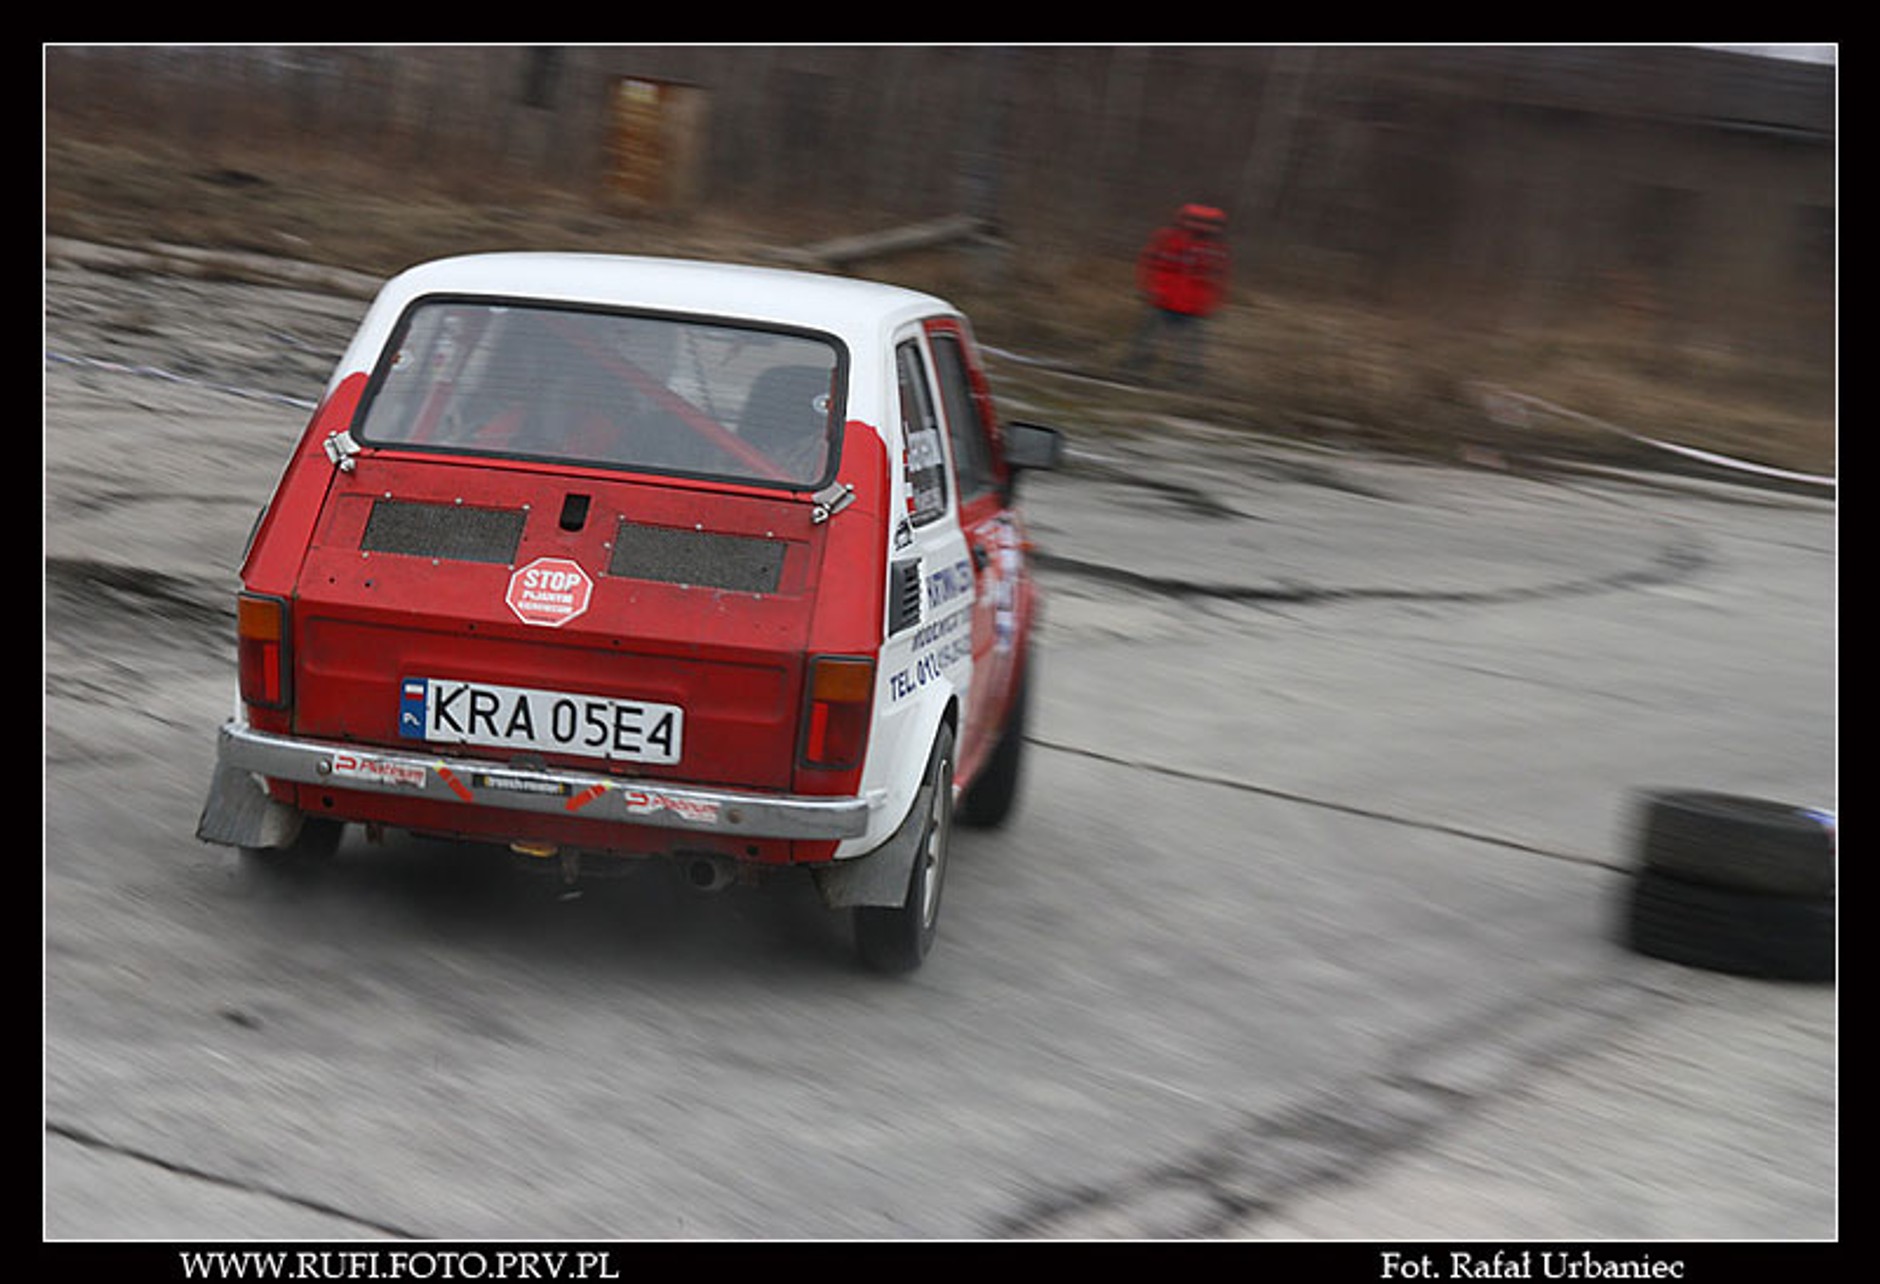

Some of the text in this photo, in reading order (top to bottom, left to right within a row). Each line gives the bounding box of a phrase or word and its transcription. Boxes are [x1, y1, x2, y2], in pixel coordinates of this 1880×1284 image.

[522, 568, 582, 591] STOP
[434, 685, 674, 757] KRA 05E4
